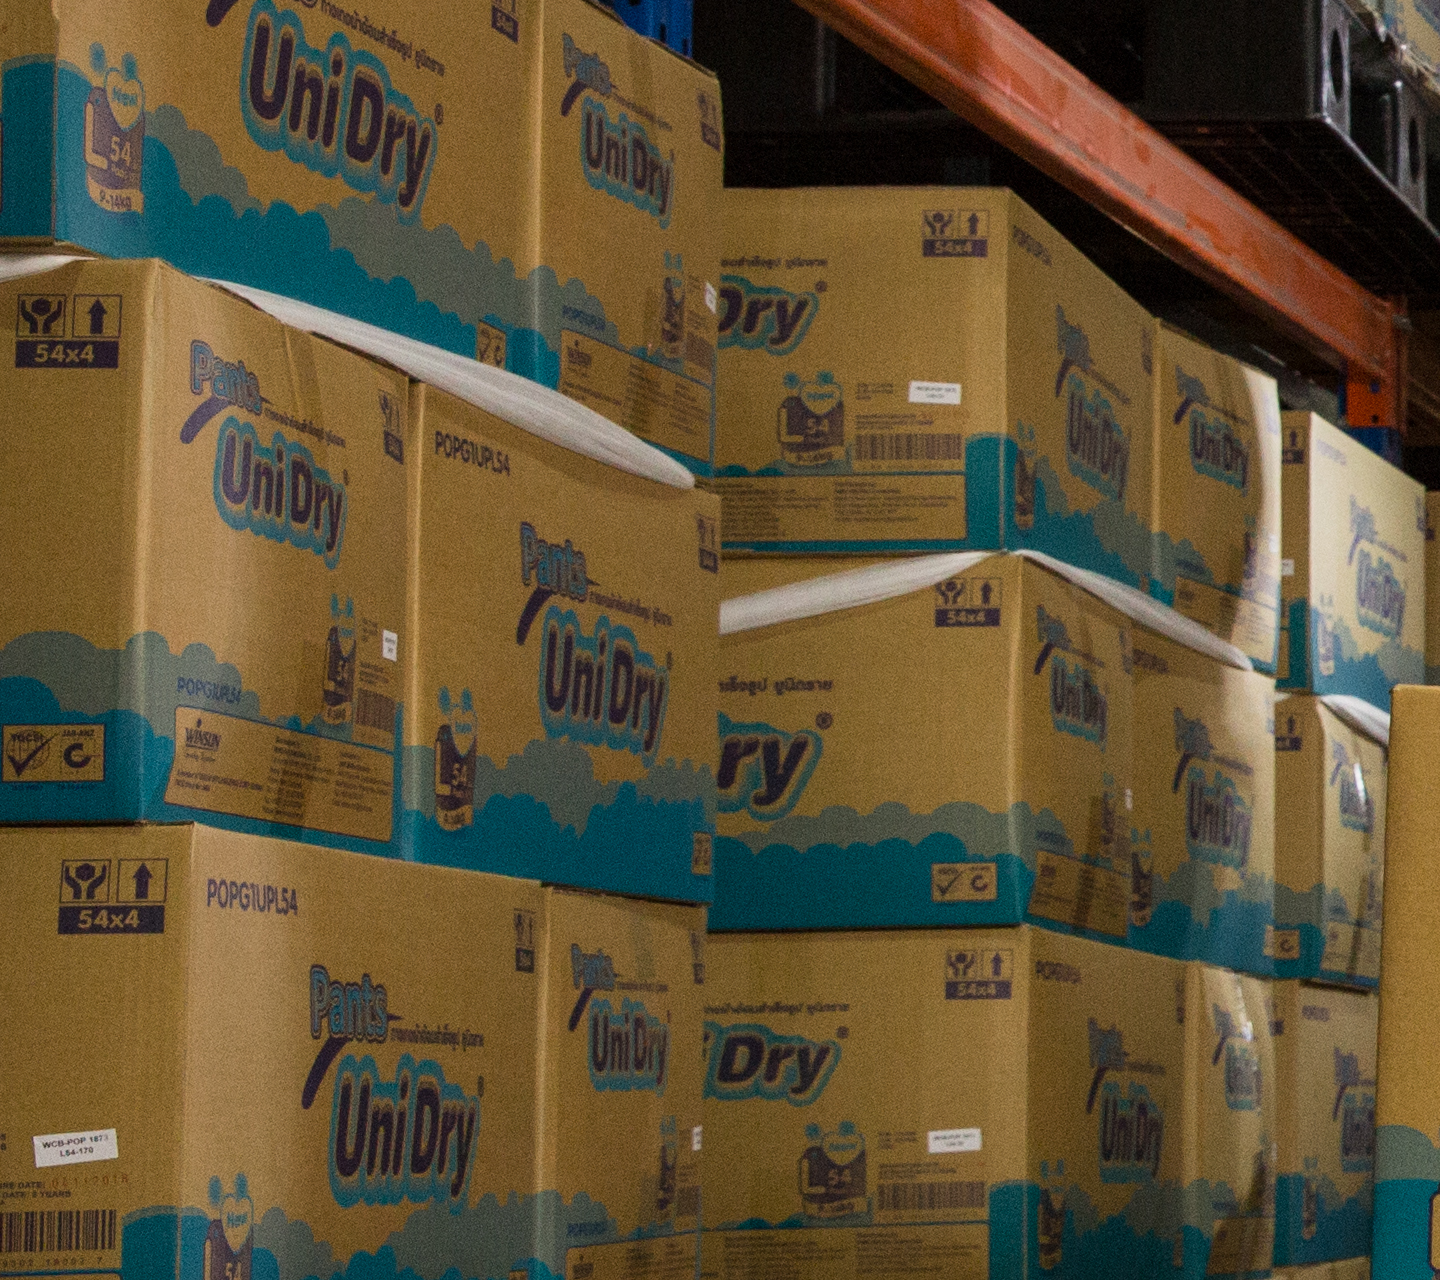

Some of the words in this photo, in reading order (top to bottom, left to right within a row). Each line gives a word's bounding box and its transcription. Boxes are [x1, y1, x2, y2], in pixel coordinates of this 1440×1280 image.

[34, 341, 96, 366] 54x4
[434, 429, 512, 478] POPG1UPL54
[76, 907, 141, 931] 54x4
[206, 878, 299, 919] POPG1UPL54
[310, 964, 388, 1041] Pants
